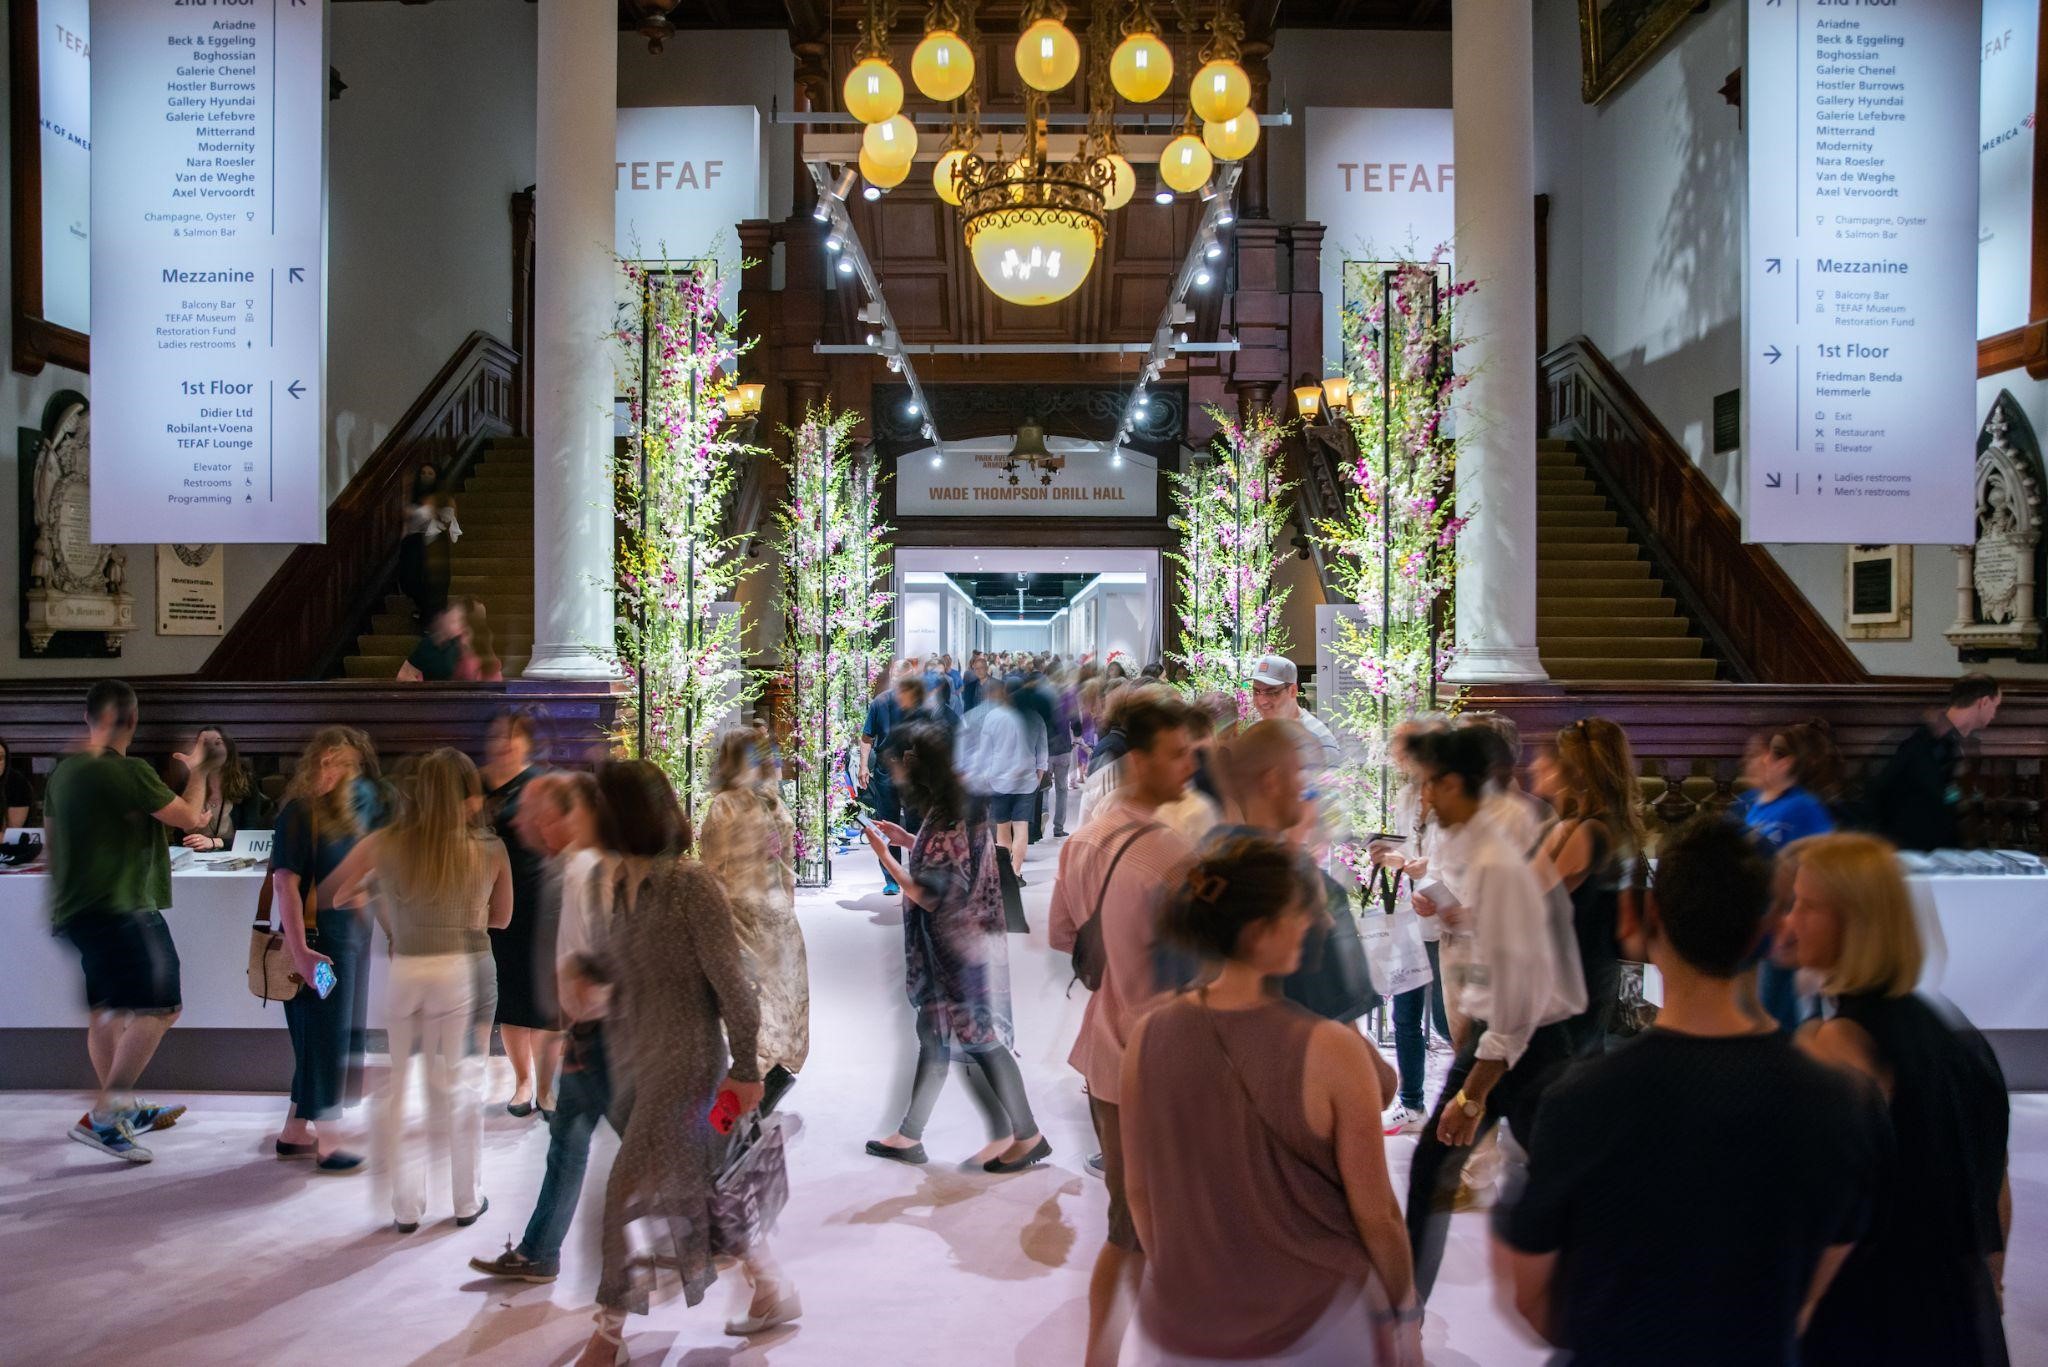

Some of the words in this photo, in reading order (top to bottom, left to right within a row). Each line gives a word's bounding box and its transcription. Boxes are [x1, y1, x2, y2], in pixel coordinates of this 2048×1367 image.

[213, 20, 255, 30] Ariadne
[1817, 19, 1860, 29] Ariadne
[168, 36, 193, 45] Beck
[197, 36, 204, 45] &
[208, 35, 255, 47] Eggeling
[1817, 34, 1841, 44] Beck
[1845, 35, 1853, 44] &
[1857, 34, 1905, 47] Eggeling
[1981, 29, 2012, 61] FAF
[193, 51, 255, 63] Boghossian
[1817, 50, 1879, 62] Boghossian
[177, 66, 215, 76] Galerie
[218, 66, 255, 75] Chenel
[1817, 65, 1855, 75] Galerie
[1858, 65, 1896, 75] Chenel
[168, 82, 206, 91] Hostler
[210, 82, 255, 90] Burrows
[1817, 80, 1857, 90] Hostler
[1859, 81, 1904, 91] Burrows
[168, 97, 206, 108] Gallery
[210, 96, 255, 108] Hyundai
[1816, 96, 1854, 108] Gallery
[1858, 96, 1904, 107] Hyundai
[166, 112, 204, 121] Galerie
[208, 111, 255, 121] Lefebvre
[1816, 111, 1854, 120] Galerie
[1859, 111, 1906, 121] Lefebvre
[197, 126, 255, 136] Mitterrand
[1817, 126, 1875, 136] Mitterrand
[1979, 127, 2019, 154] MERICA
[199, 142, 255, 153] Modernity
[1817, 141, 1873, 153] Modernity
[187, 157, 212, 167] Nara
[216, 157, 255, 166] Roesler
[1816, 157, 1841, 166] Nara
[1845, 157, 1884, 166] Roesler
[176, 173, 196, 182] Van
[200, 173, 213, 182] de
[217, 172, 255, 184] Weghe
[616, 160, 723, 190] TEFAF
[1337, 163, 1454, 193] TEFAF
[1816, 171, 1837, 181] Van
[1840, 172, 1854, 181] de
[1857, 172, 1896, 184] Weghe
[172, 188, 196, 197] Axel
[200, 187, 255, 197] Vervoordt
[1816, 187, 1840, 196] Axel
[1844, 187, 1899, 197] Vervoordt
[144, 212, 202, 223] Champagne,
[206, 212, 236, 223] Oyster
[1836, 215, 1894, 226] Champagne,
[1897, 215, 1928, 226] Oyster
[174, 228, 180, 237] &
[183, 228, 217, 237] Salmon
[221, 228, 235, 236] Bar
[1835, 230, 1842, 238] &
[1845, 230, 1880, 239] Salmon
[1883, 231, 1898, 239] Bar
[1817, 259, 1909, 274] Mezzanine
[163, 268, 254, 283] Mezzanine
[1835, 290, 1871, 301] Balcony
[1873, 291, 1889, 300] Bar
[182, 300, 218, 310] Balcony
[221, 300, 236, 308] Bar
[1836, 304, 1863, 312] TEFAF
[1866, 304, 1906, 313] Museum
[165, 314, 193, 322] TEFAF
[197, 314, 236, 322] Museum
[1835, 317, 1889, 326] Restoration
[1892, 318, 1915, 327] Fund
[156, 327, 209, 336] Restoration
[213, 327, 235, 335] Fund
[158, 340, 187, 349] Ladies
[1818, 344, 1841, 358] 1st
[1847, 344, 1889, 358] Floor
[1816, 372, 1865, 381] Friedman
[1869, 372, 1902, 382] Benda
[182, 381, 205, 395] 1st
[211, 380, 253, 394] Floor
[1817, 387, 1871, 396] Hemmerle
[201, 408, 232, 417] Didier
[236, 408, 252, 417] Ltd
[1835, 412, 1852, 421] Exit
[167, 424, 252, 433] Robilant+Voena
[1835, 428, 1885, 437] Restaurant
[178, 439, 209, 448] TEFAF
[213, 439, 253, 450] Lounge
[1835, 443, 1872, 453] Elevator
[194, 463, 232, 471] Elevator
[1835, 473, 1864, 482] Ladies
[184, 479, 232, 488] Restrooms
[929, 487, 968, 500] WADE
[973, 486, 1047, 500] THOMPSON
[1053, 487, 1089, 500] DRILL
[1093, 487, 1125, 500] HALL
[1835, 488, 1862, 496] Men's
[168, 495, 231, 505] Programming
